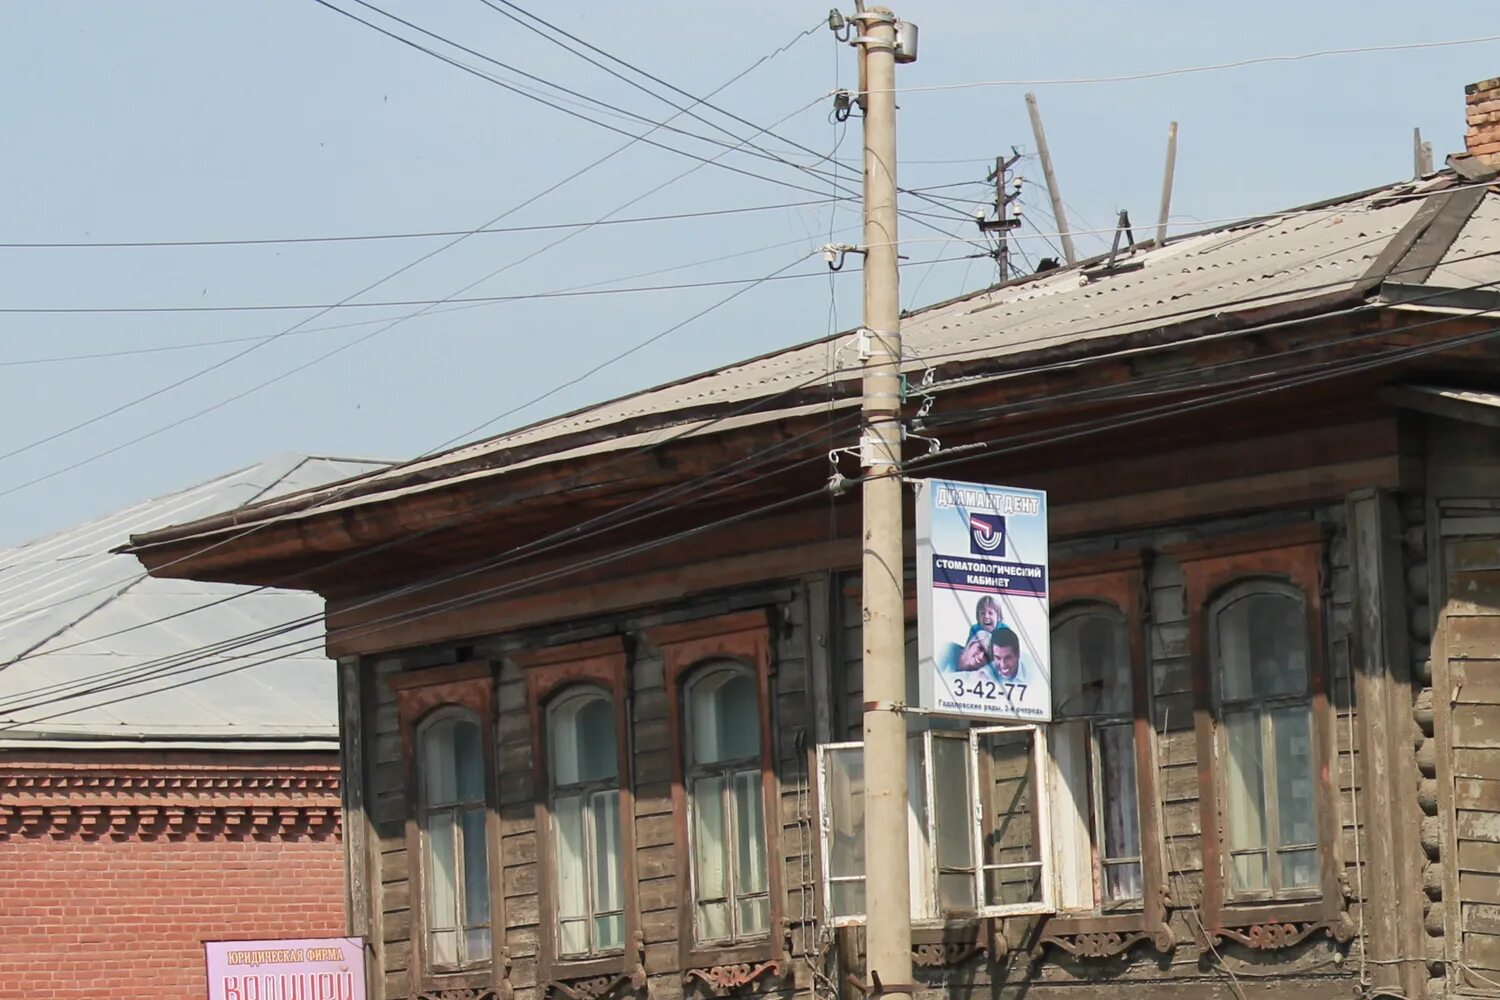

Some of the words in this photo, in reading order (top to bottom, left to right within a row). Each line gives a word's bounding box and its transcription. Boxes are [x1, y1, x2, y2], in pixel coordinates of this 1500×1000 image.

[939, 488, 1001, 510] ДИАМАНТ
[1003, 496, 1040, 514] ДЕНТ
[935, 558, 1042, 578] СТОМАТОЛОГИЧЕСКИЙ
[966, 574, 1010, 587] КАБИНЕТ
[954, 679, 1027, 702] 3-42-77
[227, 949, 304, 967] ЮРИДИЧЕСКАЯ
[306, 947, 345, 961] ФИРМА
